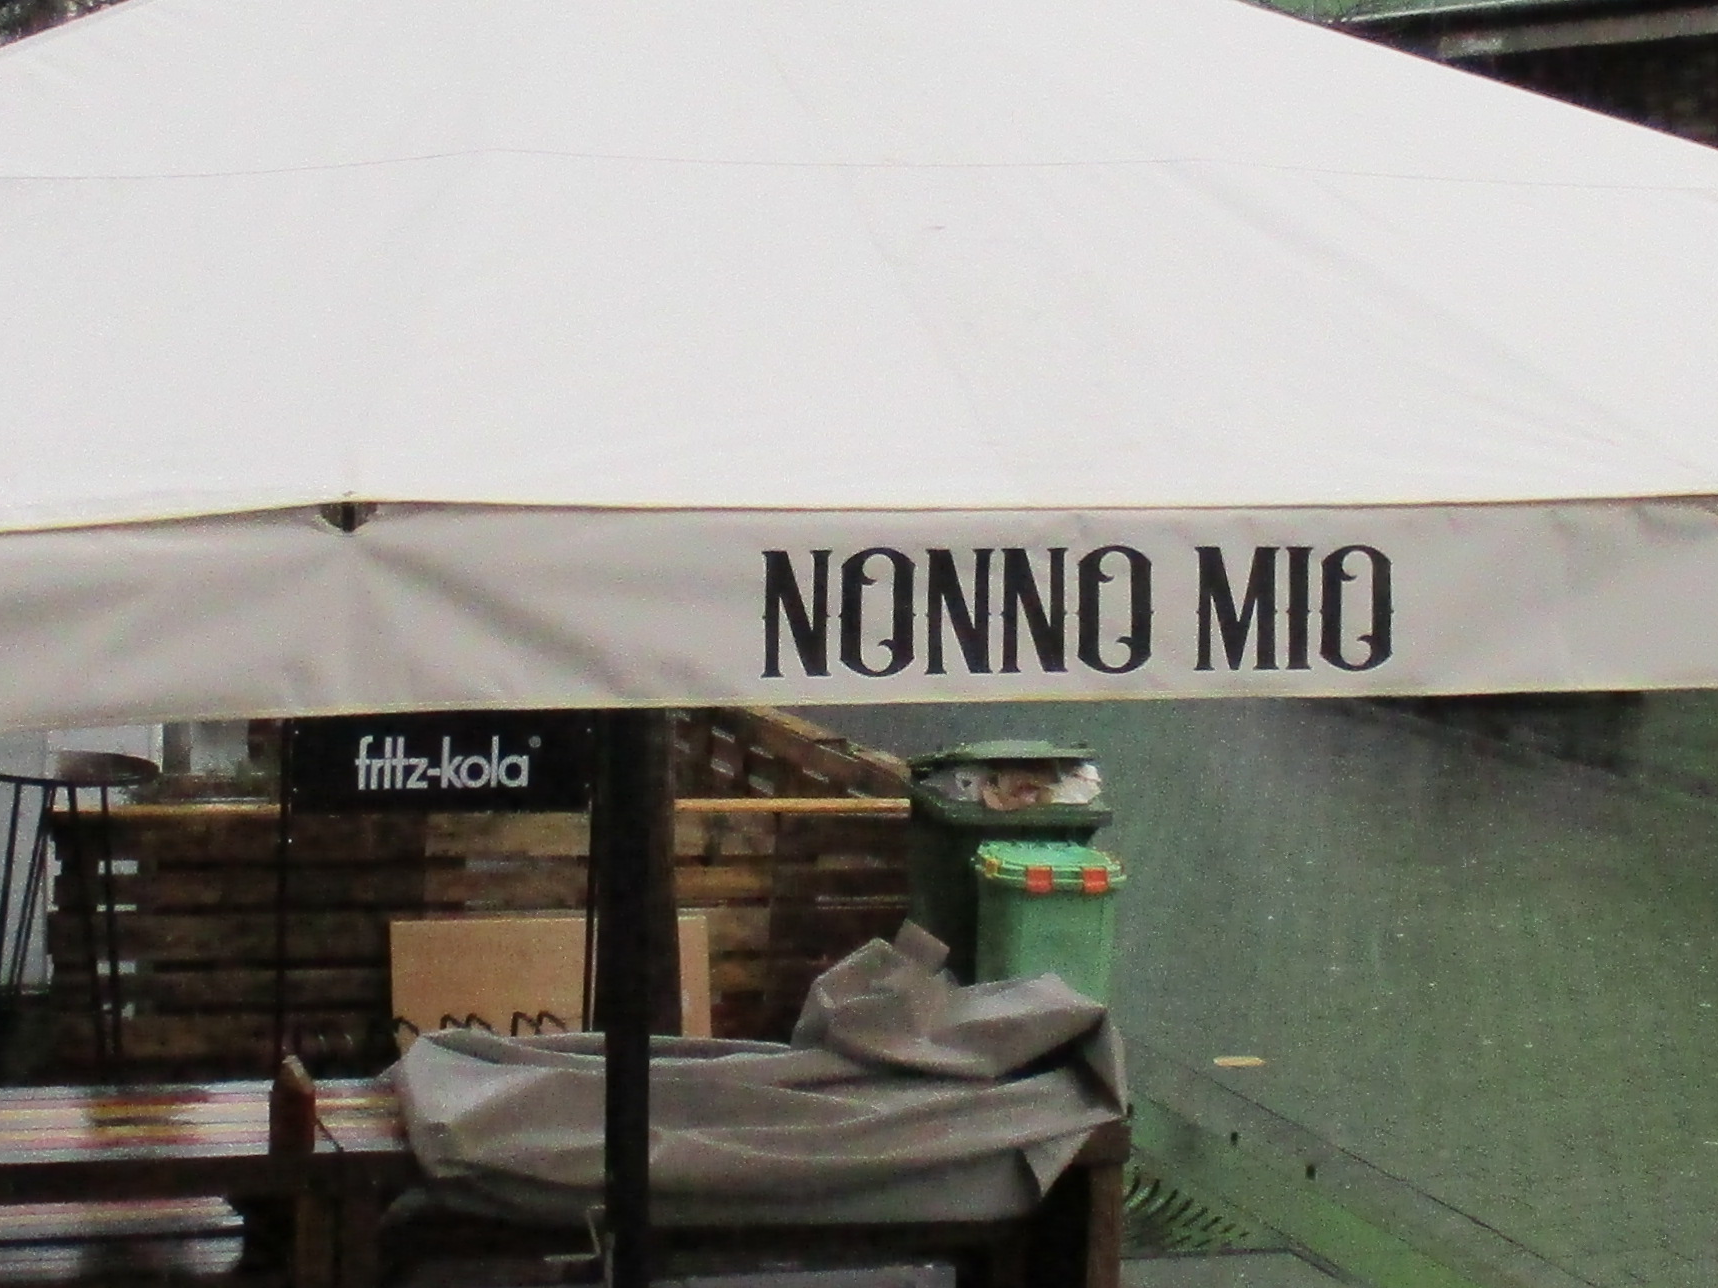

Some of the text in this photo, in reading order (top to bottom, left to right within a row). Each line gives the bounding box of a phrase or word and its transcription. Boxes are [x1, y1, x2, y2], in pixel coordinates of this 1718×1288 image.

[760, 544, 1395, 679] NONNO MIO
[355, 735, 530, 790] fritz-kola
